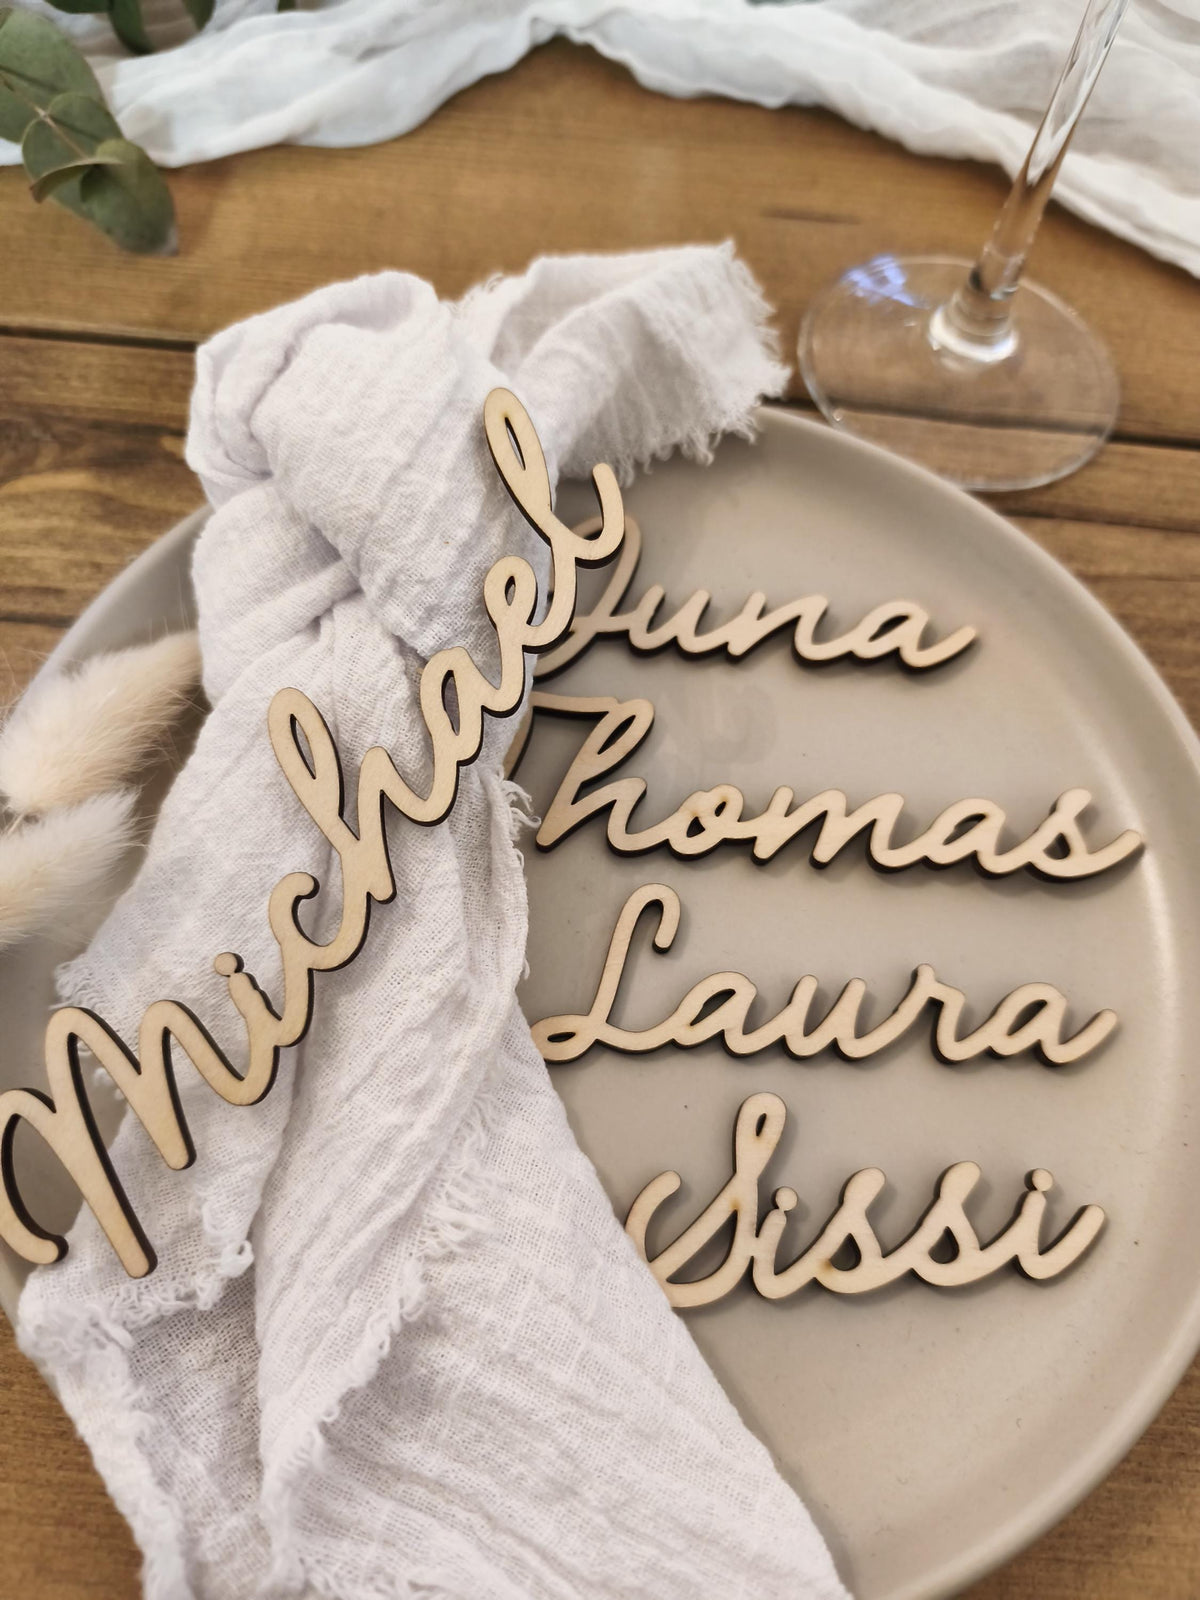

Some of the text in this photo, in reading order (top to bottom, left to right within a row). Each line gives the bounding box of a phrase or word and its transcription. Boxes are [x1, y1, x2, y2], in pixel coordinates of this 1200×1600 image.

[0, 388, 625, 1278] Michael
[532, 883, 1119, 1065] Laura
[626, 1092, 1106, 1308] Sissi
